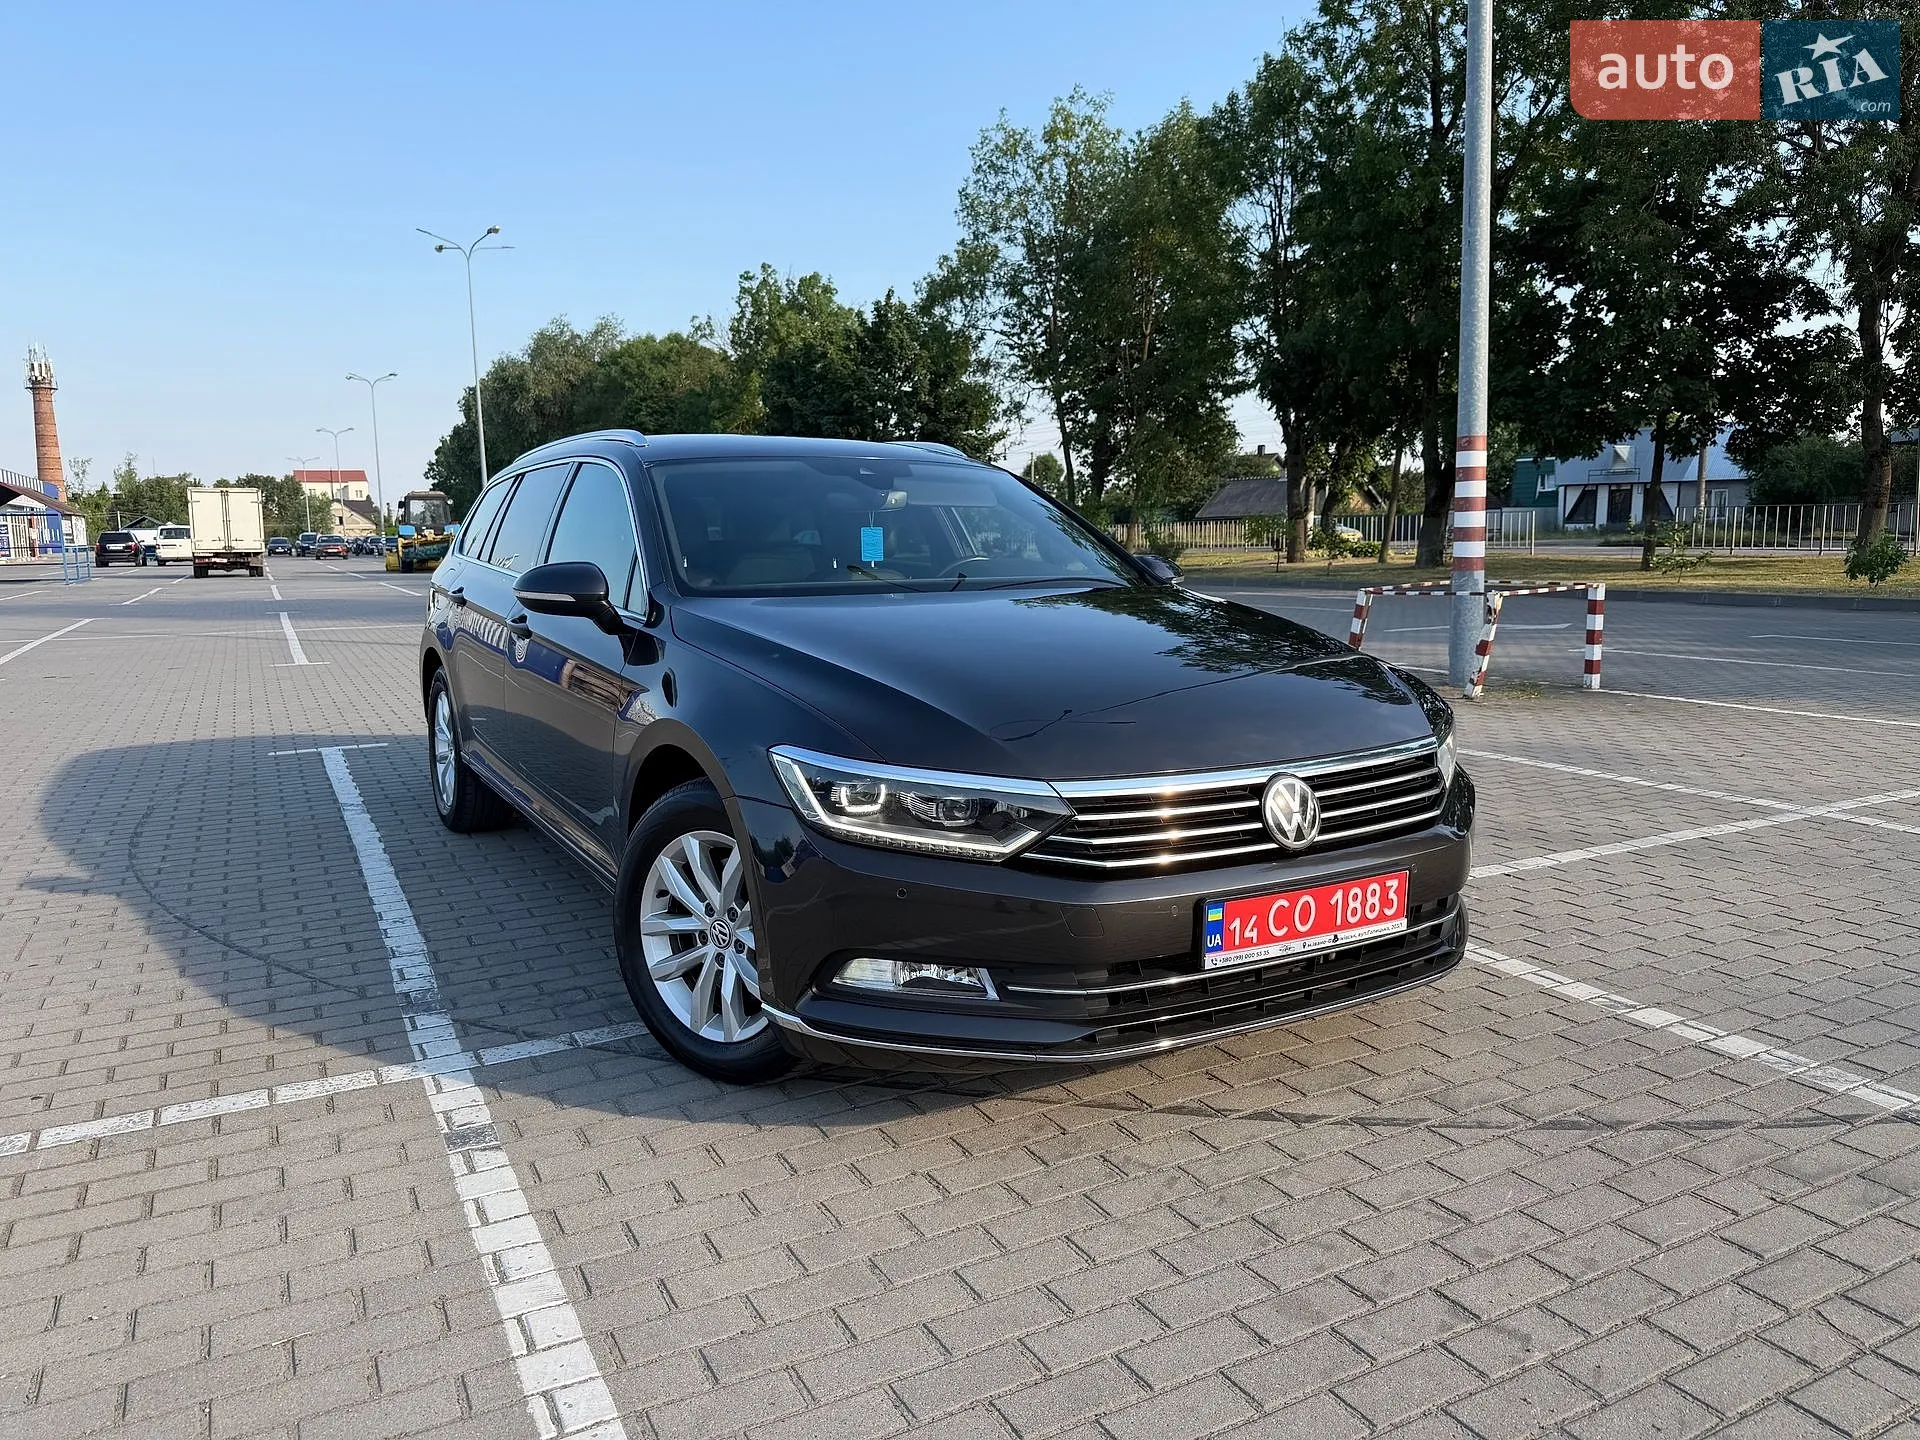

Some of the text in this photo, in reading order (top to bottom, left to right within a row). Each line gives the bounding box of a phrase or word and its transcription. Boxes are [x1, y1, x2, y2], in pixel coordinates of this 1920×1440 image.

[1228, 878, 1400, 946] 14 CO 1883
[1207, 934, 1222, 948] UA
